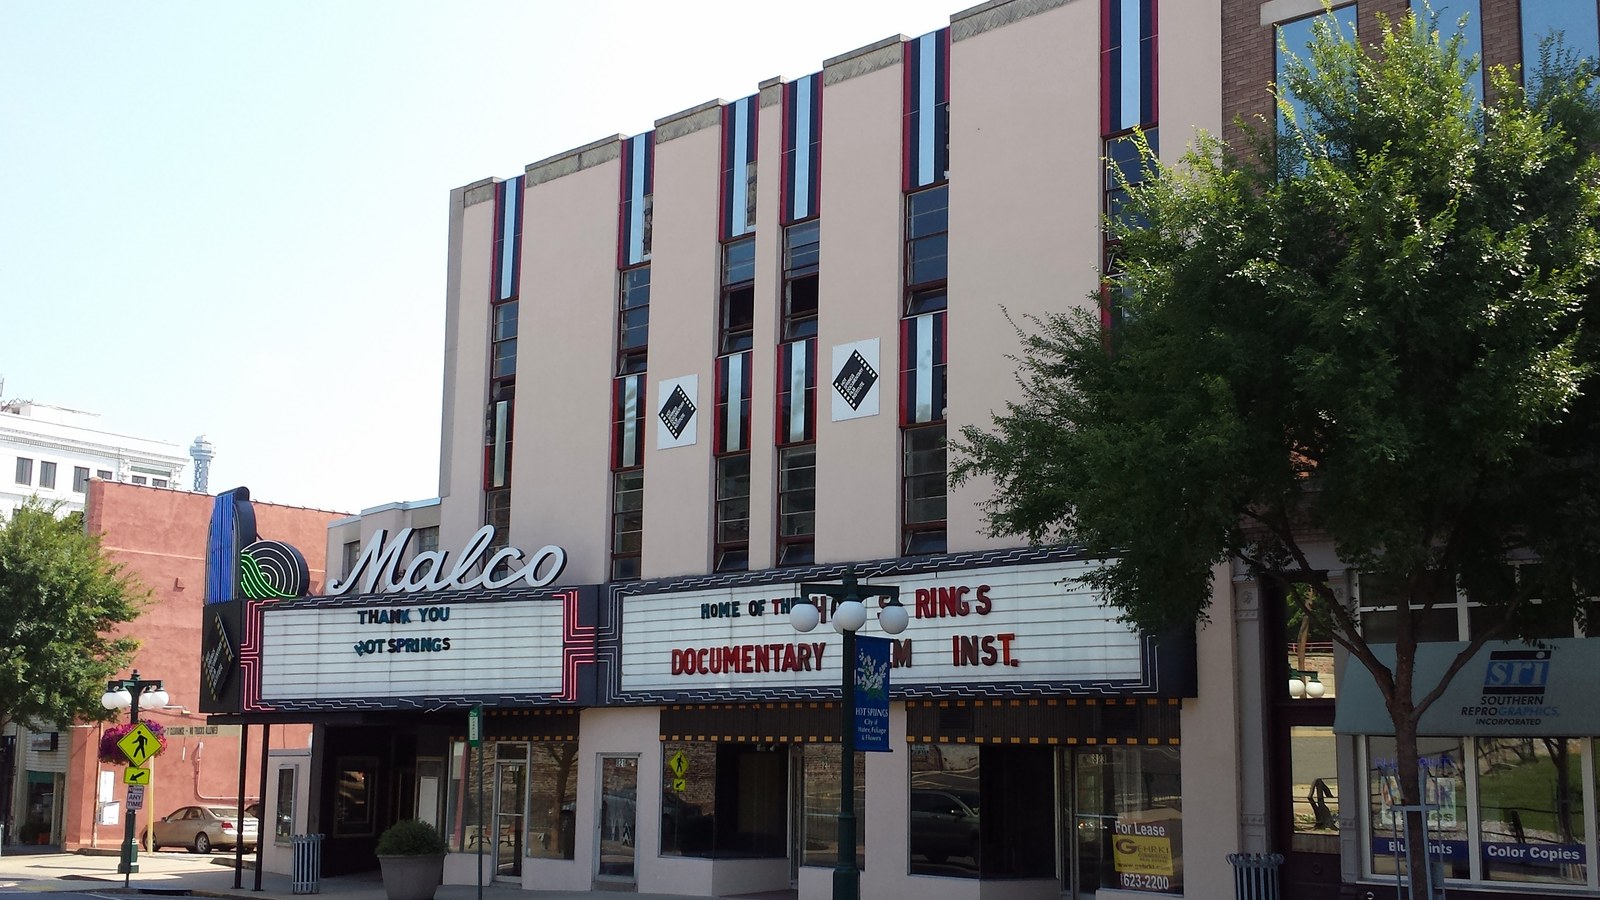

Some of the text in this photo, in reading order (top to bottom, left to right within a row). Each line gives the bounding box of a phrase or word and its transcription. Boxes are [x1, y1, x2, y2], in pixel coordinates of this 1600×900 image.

[327, 524, 567, 595] Malco
[357, 606, 450, 625] THANK YOU
[700, 600, 740, 619] HOME
[748, 599, 766, 617] OF
[387, 636, 451, 654] SPRINGS
[671, 642, 826, 676] DOCUMENTARY
[952, 633, 1019, 668] INST.
[1487, 650, 1547, 686] sri
[1480, 695, 1545, 706] SOUTHERN
[1475, 717, 1542, 726] INCORPORATED
[128, 793, 142, 801] ANY
[1114, 820, 1165, 836] For Lease
[1487, 845, 1526, 858] Color
[1529, 846, 1581, 862] Copies
